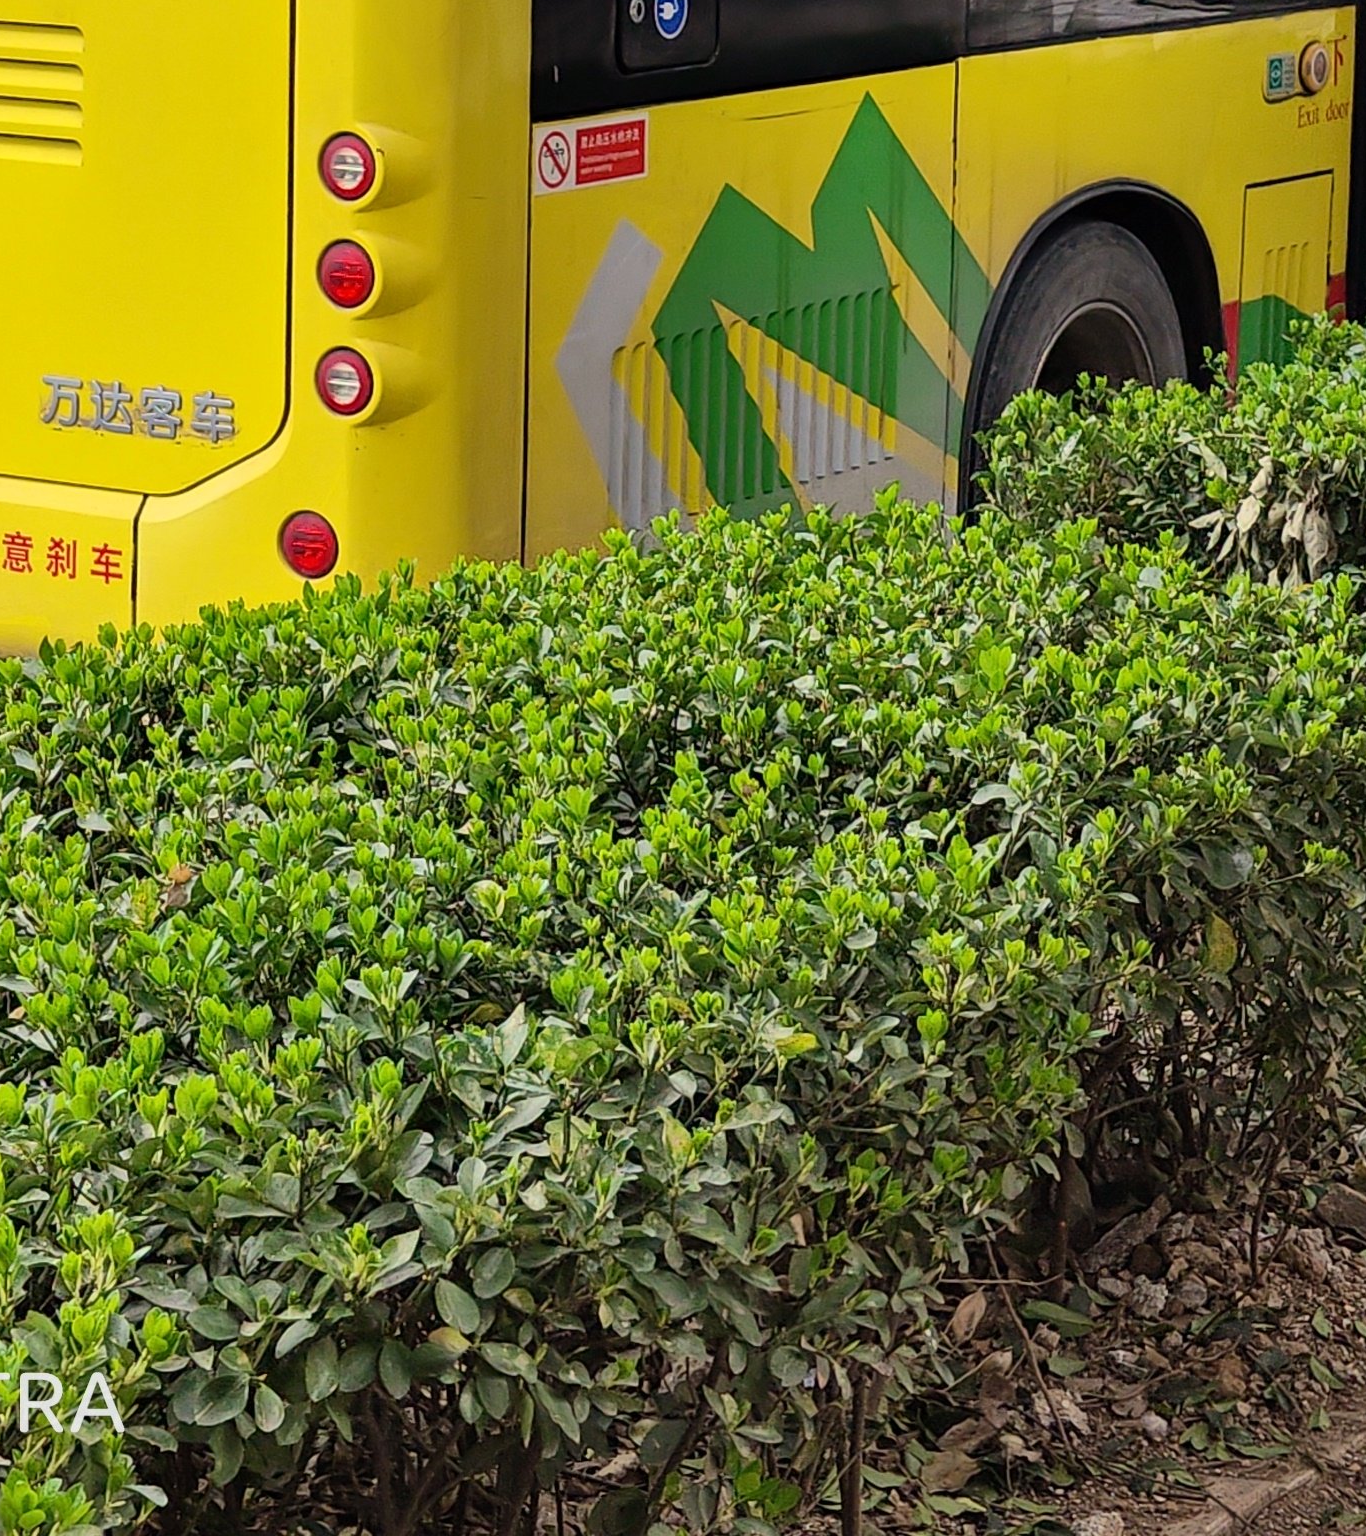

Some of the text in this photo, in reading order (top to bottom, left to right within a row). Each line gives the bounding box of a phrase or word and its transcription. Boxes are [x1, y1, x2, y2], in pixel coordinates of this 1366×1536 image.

[1297, 99, 1350, 129] Exit door
[40, 374, 236, 444] 万达客车
